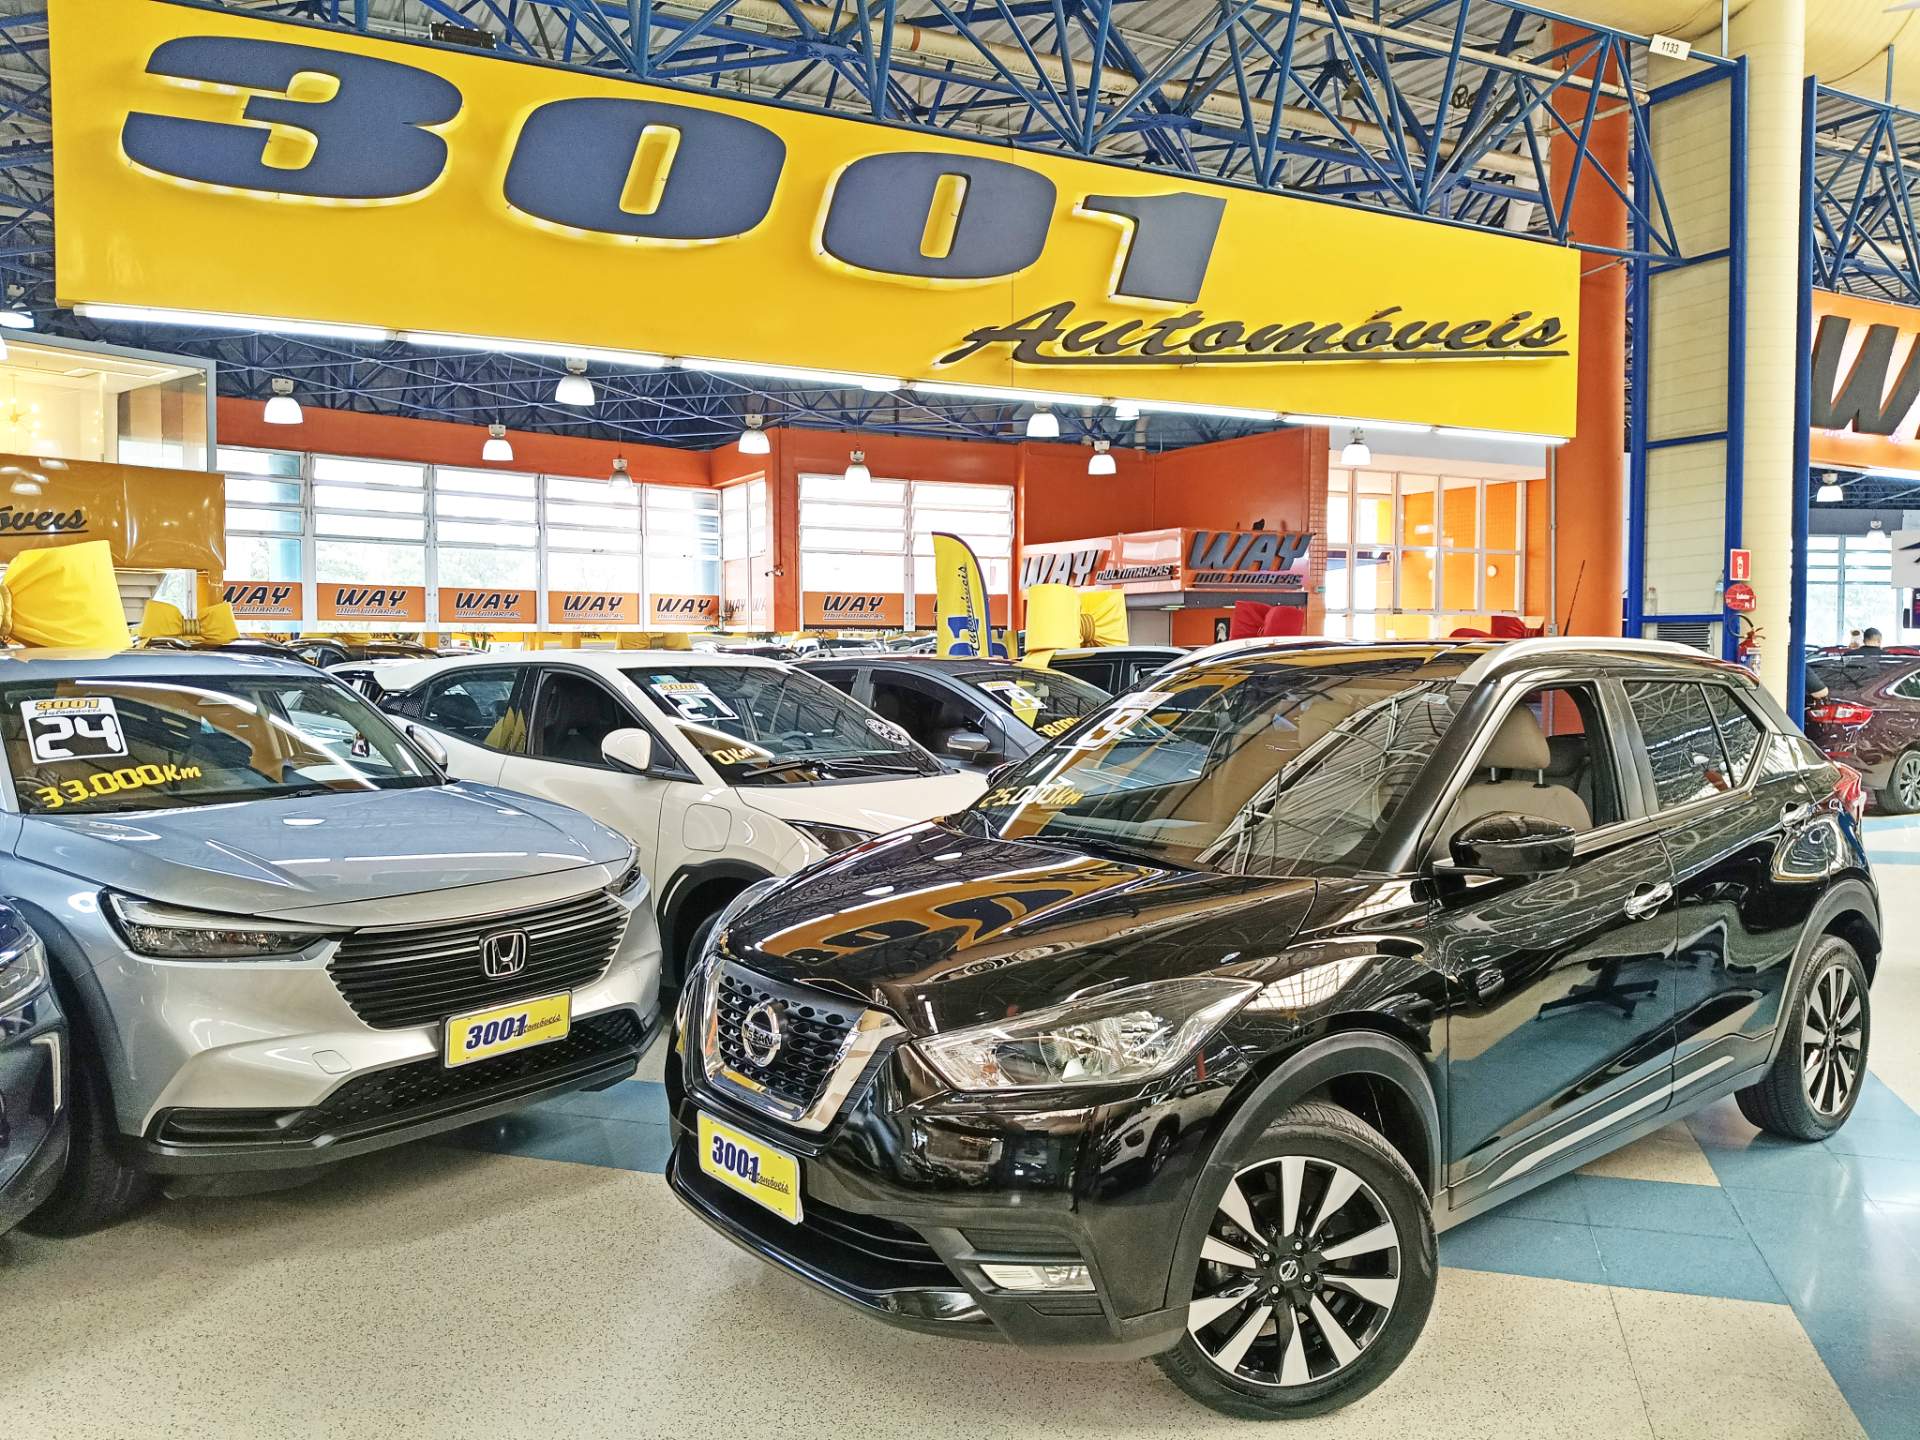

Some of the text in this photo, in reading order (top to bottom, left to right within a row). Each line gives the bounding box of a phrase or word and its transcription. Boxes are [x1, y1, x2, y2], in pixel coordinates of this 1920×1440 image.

[1662, 42, 1679, 54] 1133
[119, 34, 1228, 305] 3001
[933, 301, 1569, 363] Automóveis
[1020, 549, 1099, 588] WAY
[1187, 531, 1313, 571] WAY
[336, 587, 407, 607] WAY
[455, 592, 520, 610] WAY
[563, 595, 623, 612] WAY
[657, 597, 711, 613] WAY
[823, 595, 884, 612] WAY
[35, 716, 122, 758] 24
[466, 1013, 527, 1050] 3001
[712, 1135, 759, 1184] 3001
